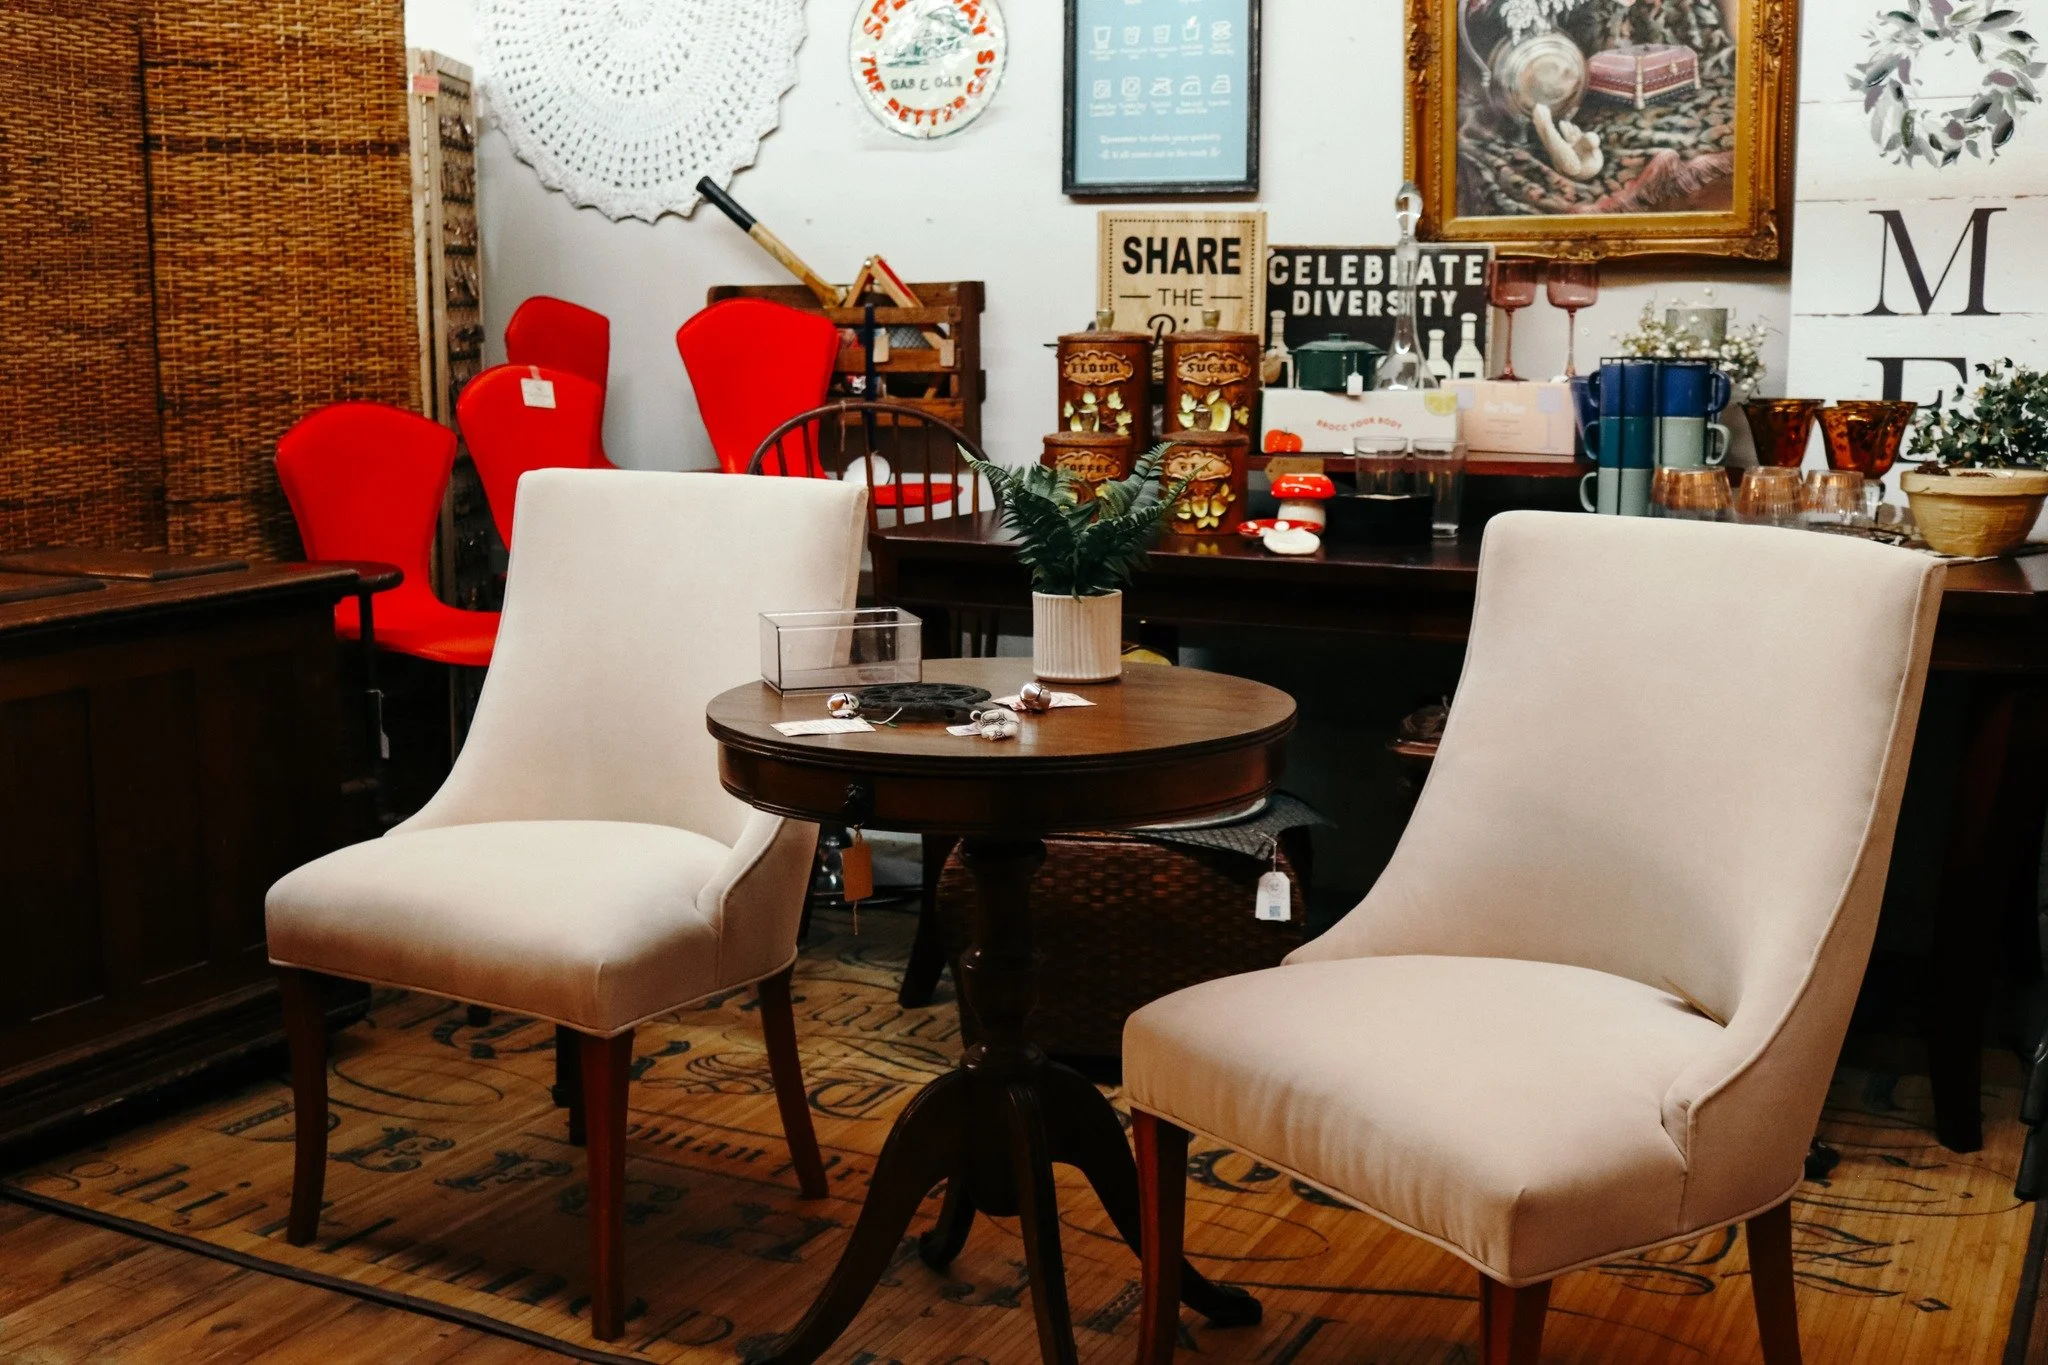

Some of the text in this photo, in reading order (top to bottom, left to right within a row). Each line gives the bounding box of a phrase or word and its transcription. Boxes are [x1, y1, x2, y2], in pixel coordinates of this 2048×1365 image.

[1122, 236, 1241, 275] SHARE
[1158, 288, 1204, 307] THE
[1071, 362, 1120, 375] FLOUR
[1187, 362, 1240, 374] SUGAR
[1316, 416, 1403, 432] BROCC YOUR BODY
